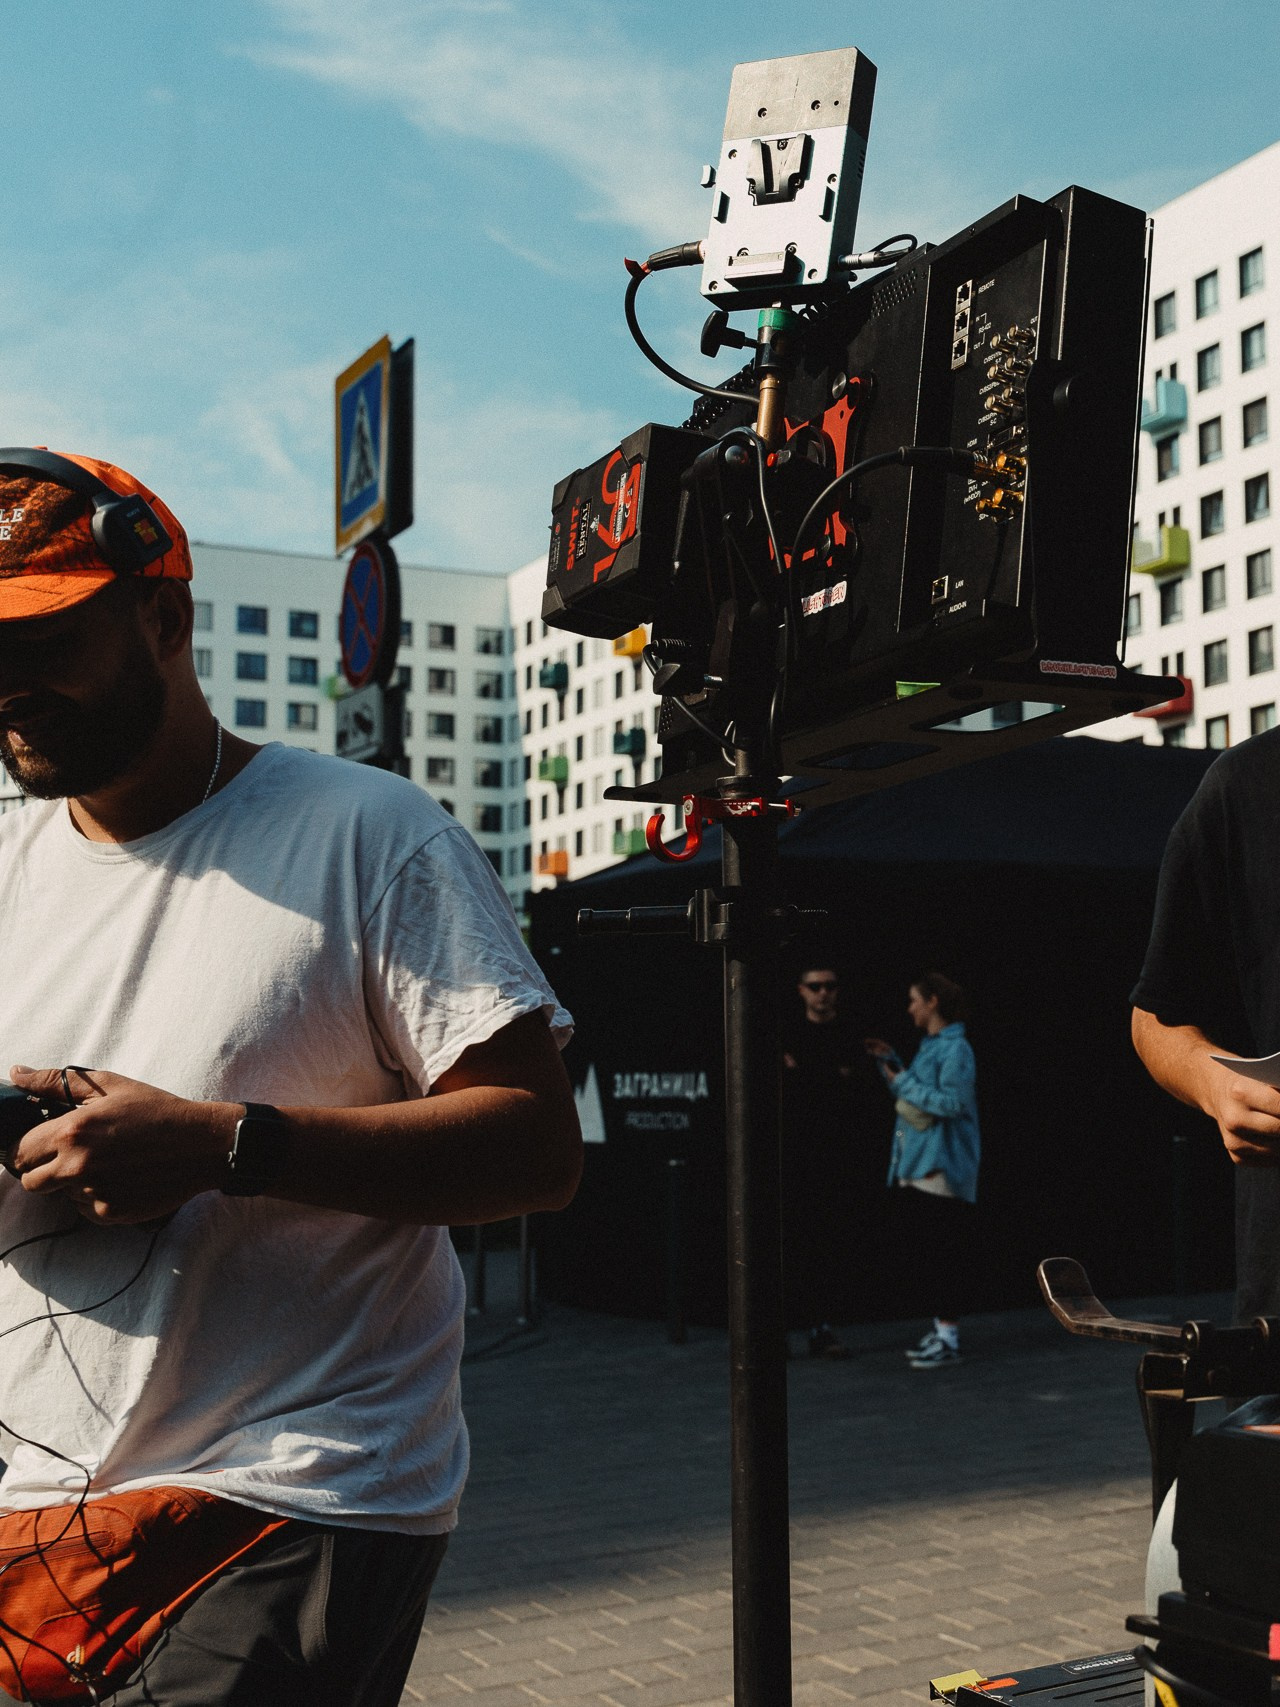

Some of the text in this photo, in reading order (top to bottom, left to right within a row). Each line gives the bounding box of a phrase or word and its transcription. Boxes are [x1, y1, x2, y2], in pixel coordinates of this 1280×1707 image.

[978, 279, 996, 294] REMOTE
[567, 506, 579, 571] SWIT
[578, 503, 589, 557] RENTAL
[955, 580, 964, 589] LAN
[948, 601, 967, 613] AUDIO-IN
[613, 1072, 709, 1101] ЗАГРАНИЦА
